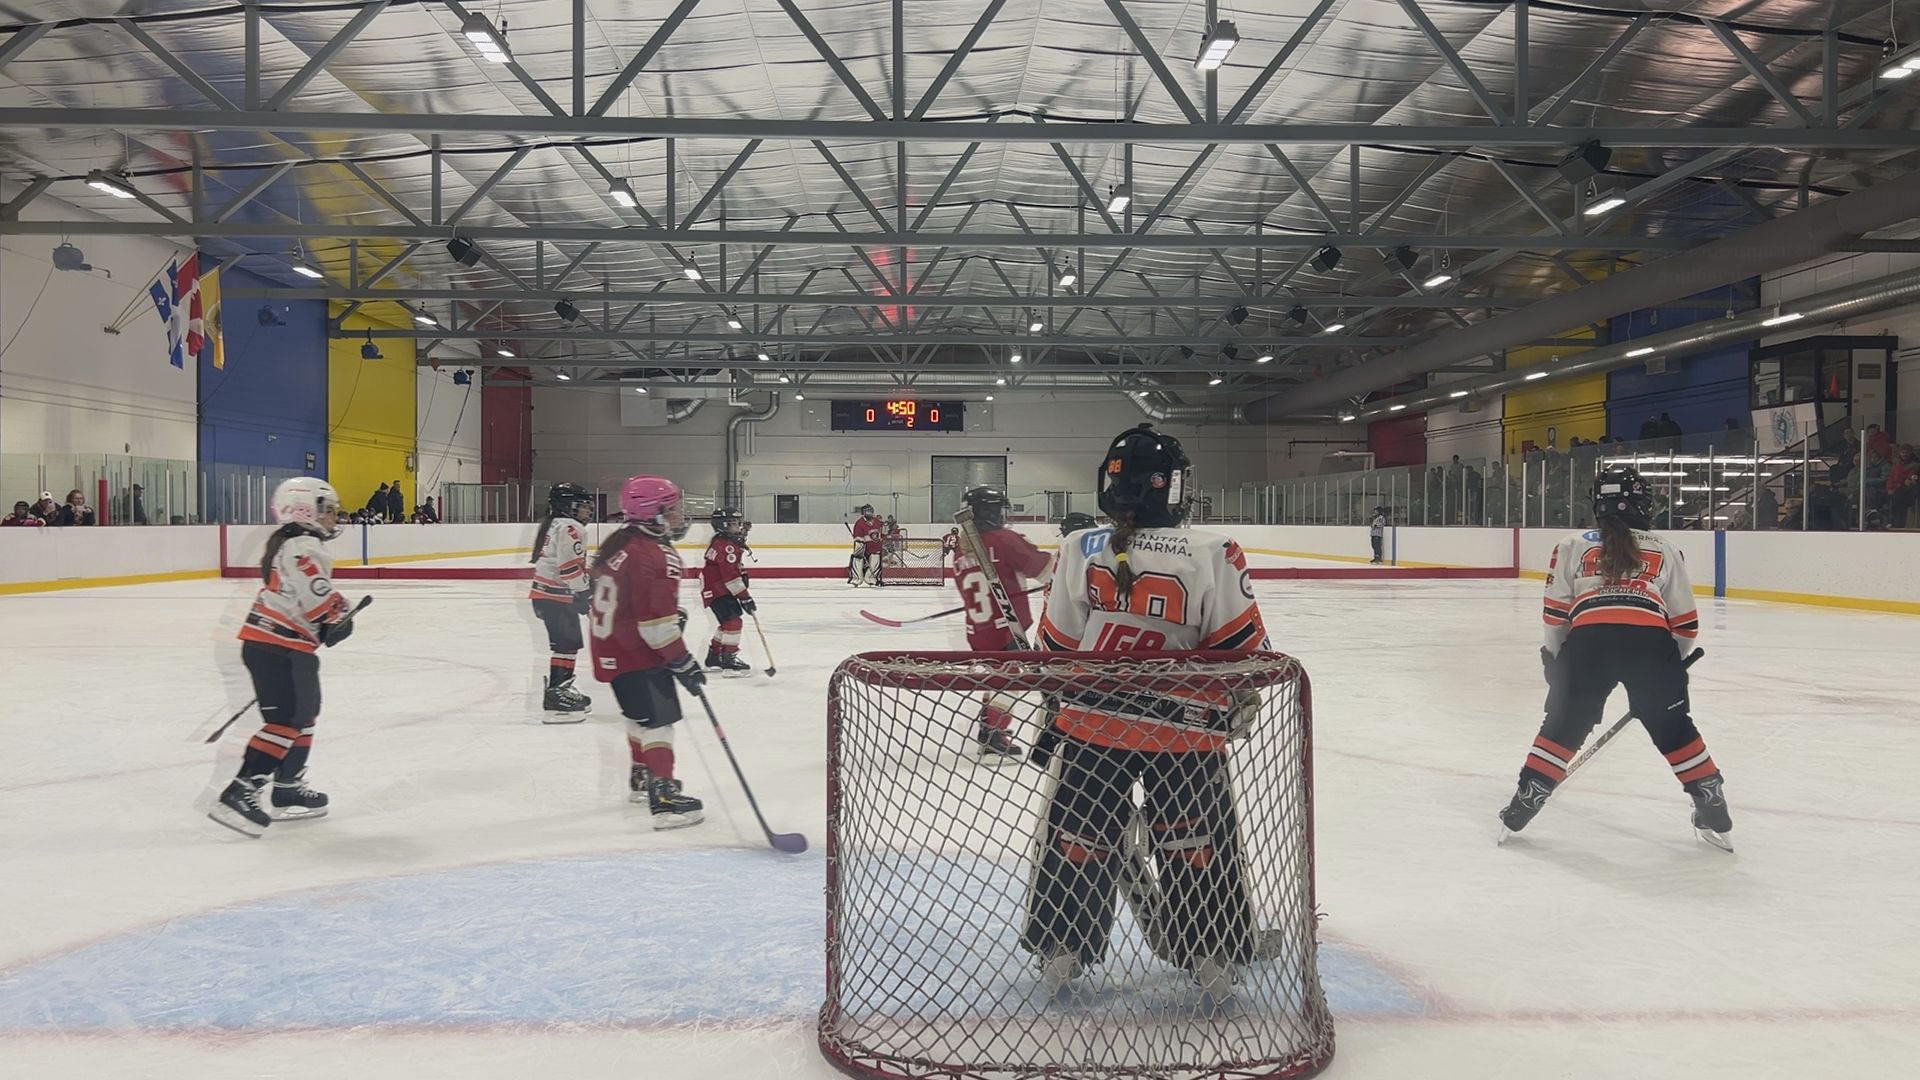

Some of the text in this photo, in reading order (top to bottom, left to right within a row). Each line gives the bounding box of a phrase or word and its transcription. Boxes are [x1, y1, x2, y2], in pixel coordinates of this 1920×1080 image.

[887, 401, 915, 415] 4:50
[866, 409, 874, 422] 0
[907, 416, 914, 427] 2
[930, 409, 939, 423] 0
[1133, 532, 1189, 545] ANTRA
[963, 571, 993, 623] 3
[592, 575, 618, 639] 9
